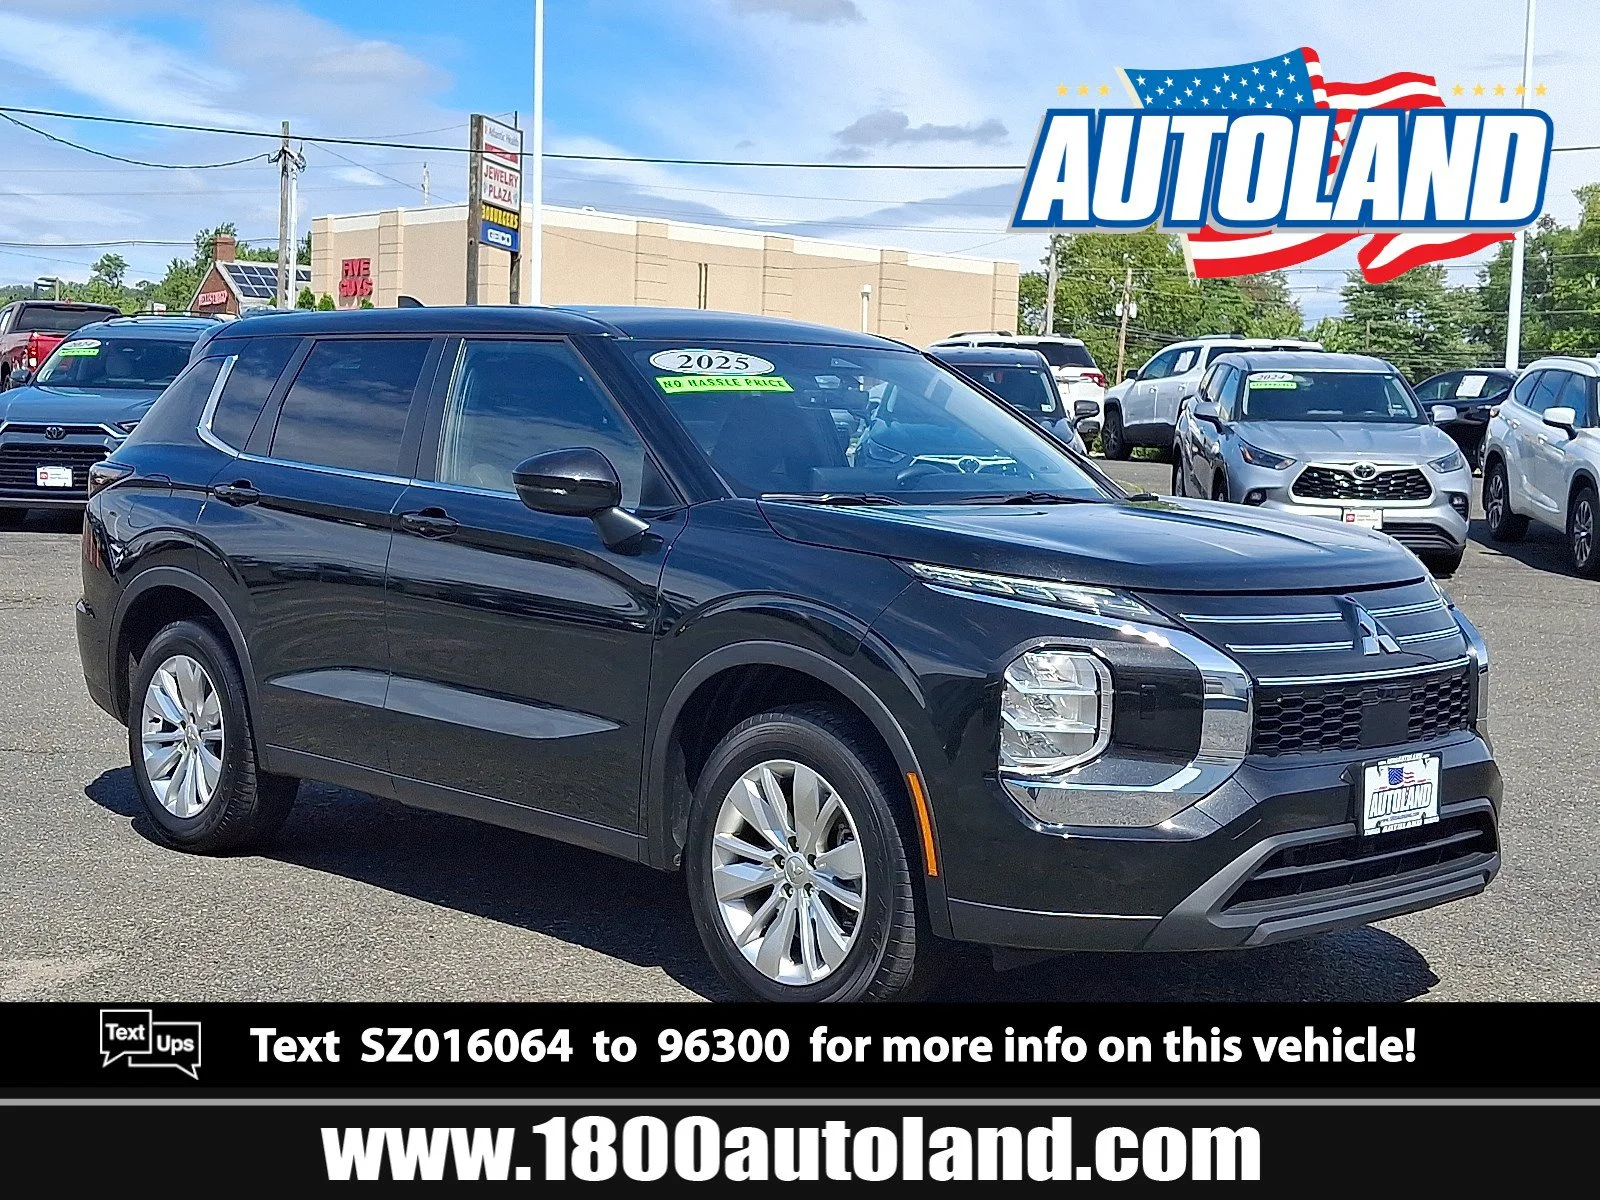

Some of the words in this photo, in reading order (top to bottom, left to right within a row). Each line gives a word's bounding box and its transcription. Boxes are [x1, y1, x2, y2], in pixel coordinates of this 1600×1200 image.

[484, 164, 518, 188] JEWELRY
[488, 184, 512, 205] PLAZA
[488, 229, 512, 247] GEICO
[341, 258, 371, 277] FIVE
[338, 278, 374, 297] GUYS
[677, 354, 750, 371] 2025
[662, 380, 682, 389] NO
[688, 379, 741, 388] HASSLE
[744, 378, 787, 388] PRICE
[1367, 782, 1433, 820] AUTOLAND
